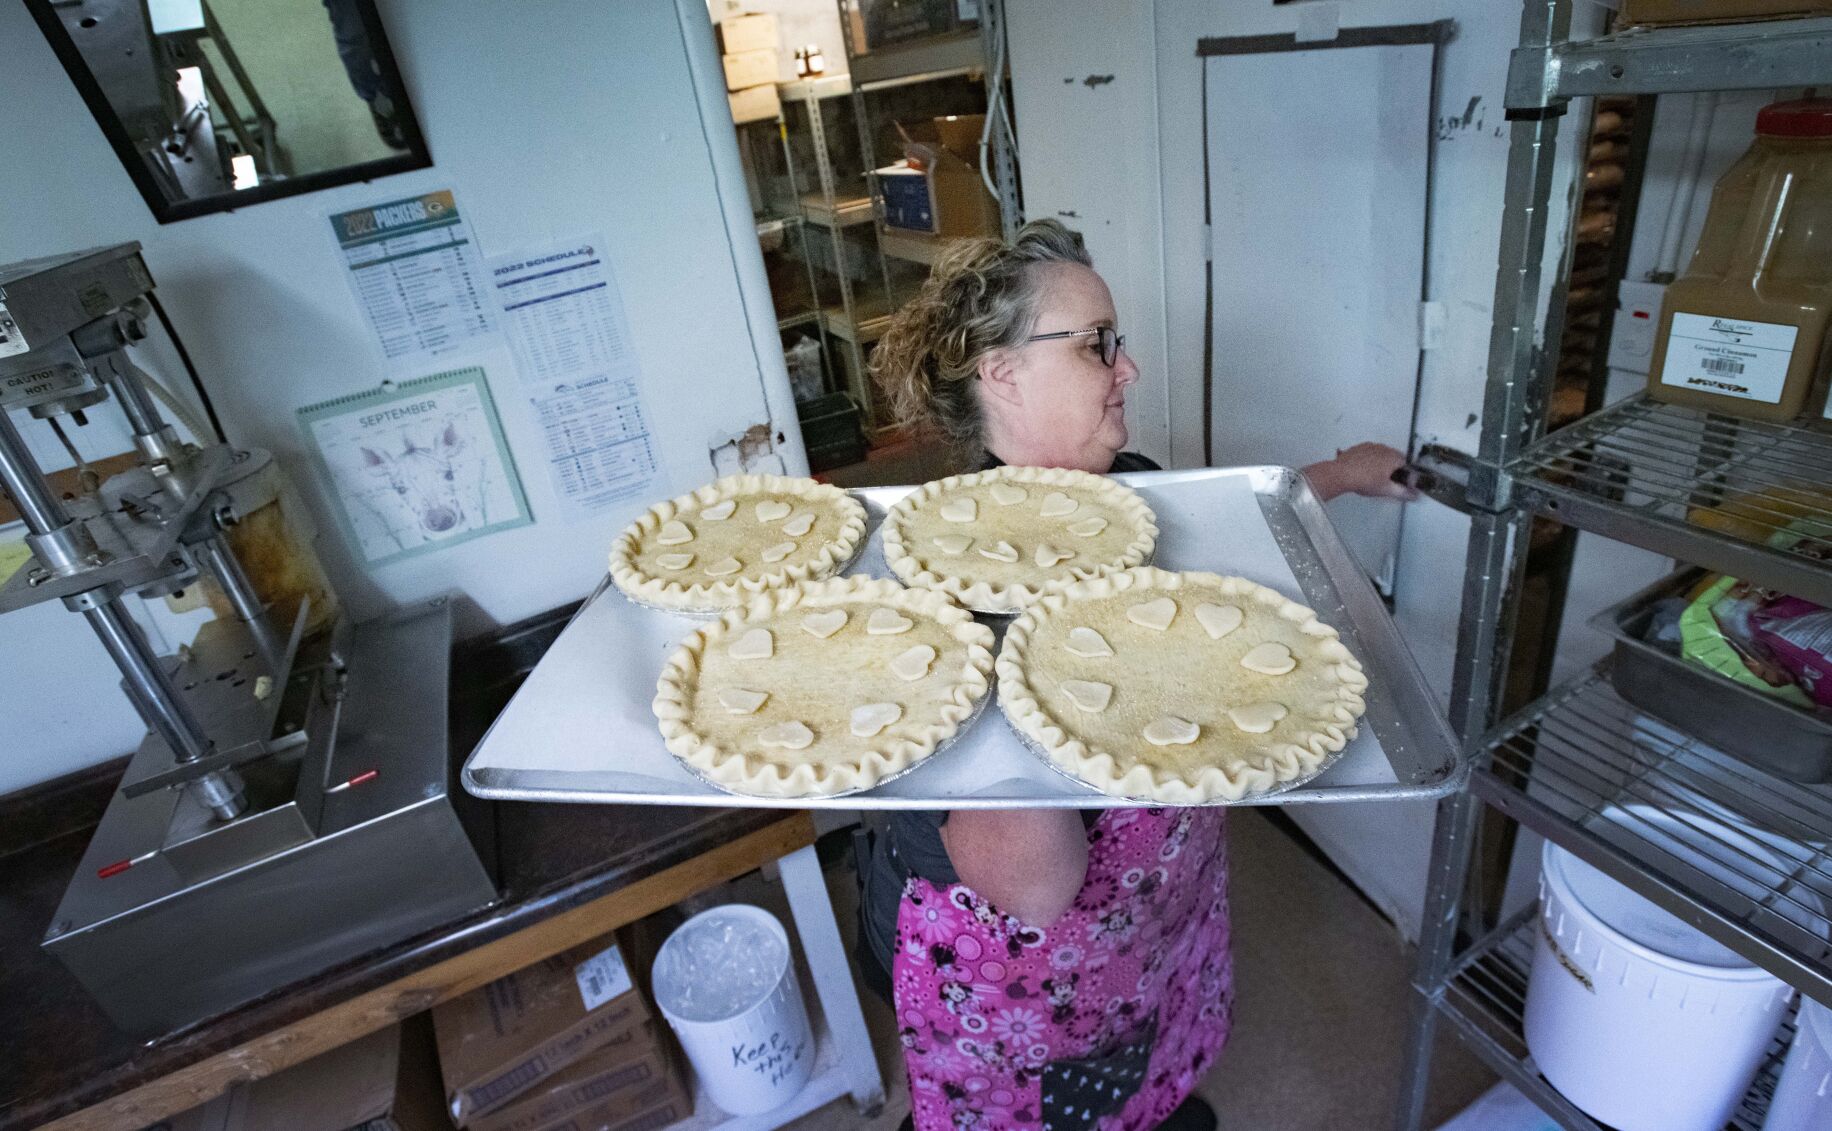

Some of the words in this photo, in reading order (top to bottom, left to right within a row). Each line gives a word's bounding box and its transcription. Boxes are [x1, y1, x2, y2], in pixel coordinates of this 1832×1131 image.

[342, 211, 378, 236] 2022
[373, 201, 427, 229] PACKERS
[494, 263, 525, 276] 2022
[525, 248, 587, 267] SCHEDULE
[1694, 344, 1720, 353] Ground
[1721, 347, 1758, 358] Cinnamon
[25, 382, 54, 395] HOT!
[359, 400, 437, 428] SEPTEMBER
